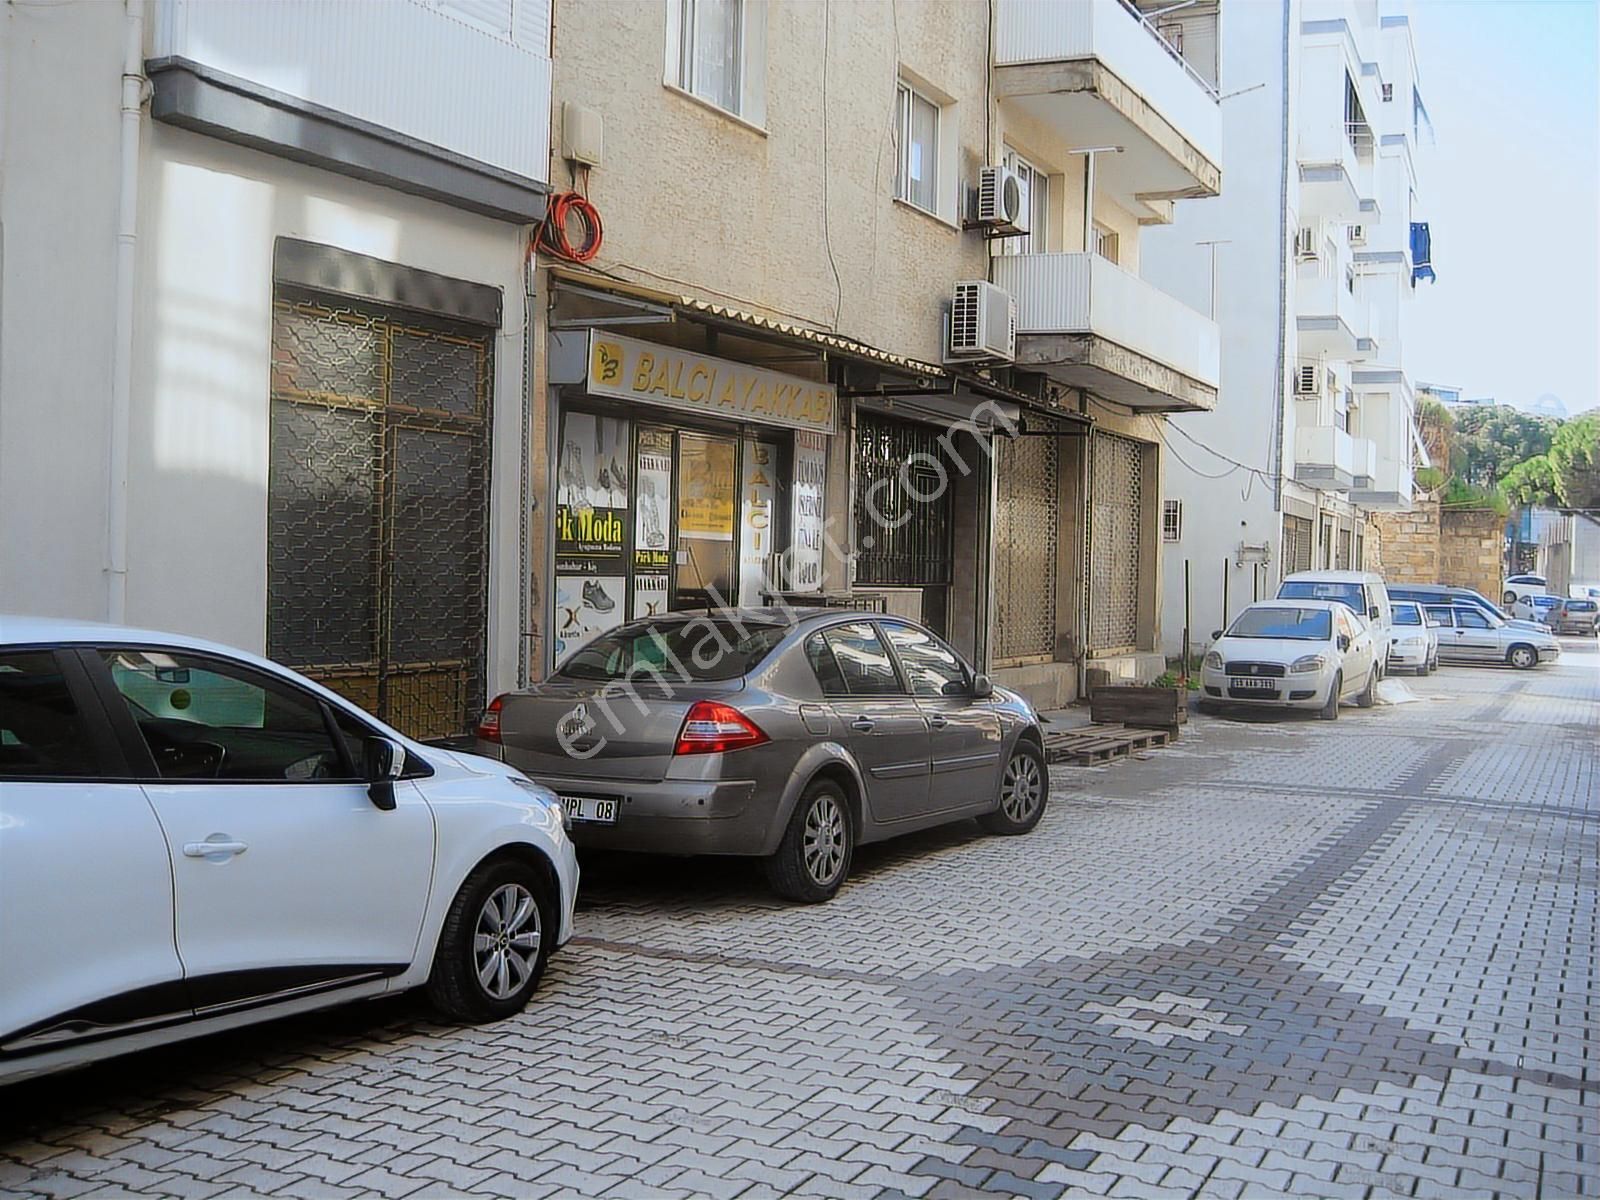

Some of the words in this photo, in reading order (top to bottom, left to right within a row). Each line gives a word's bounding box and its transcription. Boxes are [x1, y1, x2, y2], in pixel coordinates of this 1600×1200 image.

[633, 352, 717, 404] BALCI
[719, 371, 833, 425] AYAKKABI
[747, 441, 770, 550] BALCI
[578, 507, 622, 543] Moda
[596, 801, 613, 819] 08
